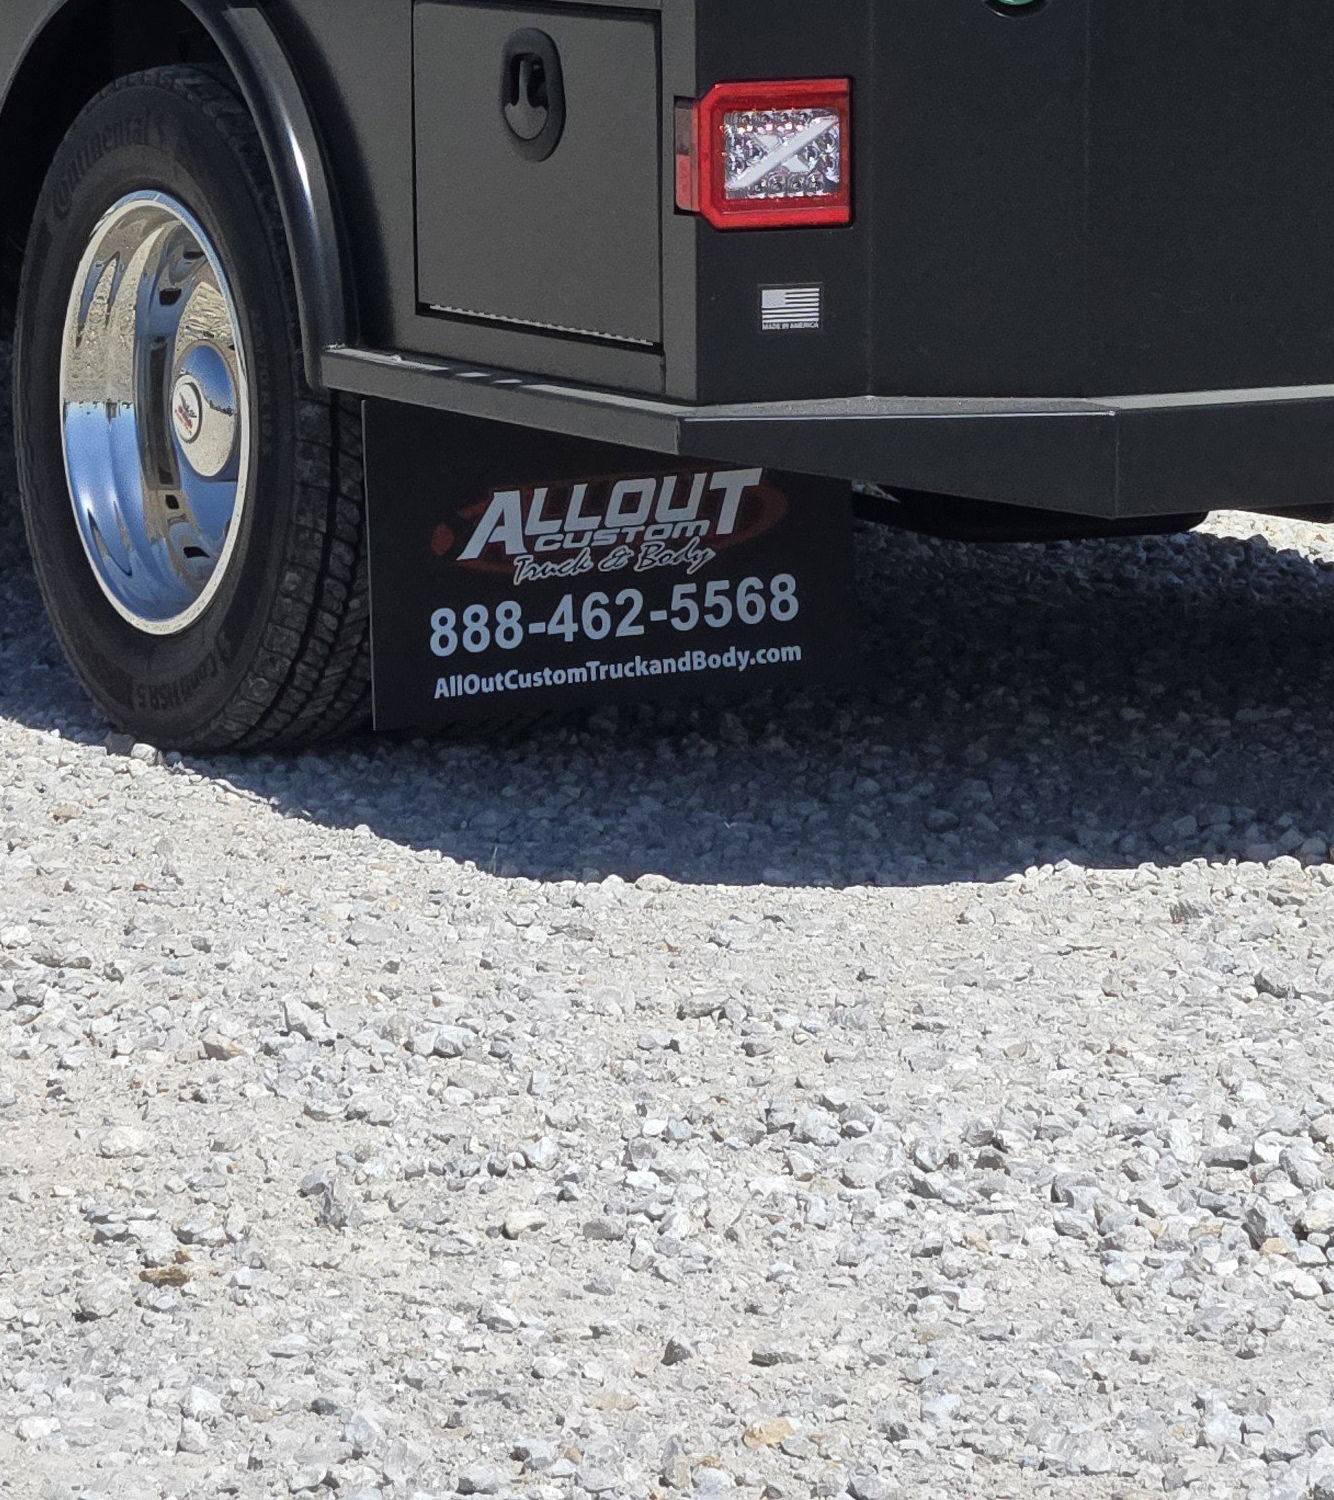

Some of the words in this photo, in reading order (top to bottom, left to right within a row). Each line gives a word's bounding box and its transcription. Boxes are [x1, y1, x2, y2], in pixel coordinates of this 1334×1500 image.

[456, 467, 763, 561] ALLOUT
[534, 519, 711, 552] CUSTOM
[512, 547, 593, 586] Truck
[597, 548, 629, 571] &
[633, 536, 717, 575] Body
[429, 572, 800, 658] 888-462-5568
[433, 643, 802, 700] AllOutCustomTruckandBody.com
